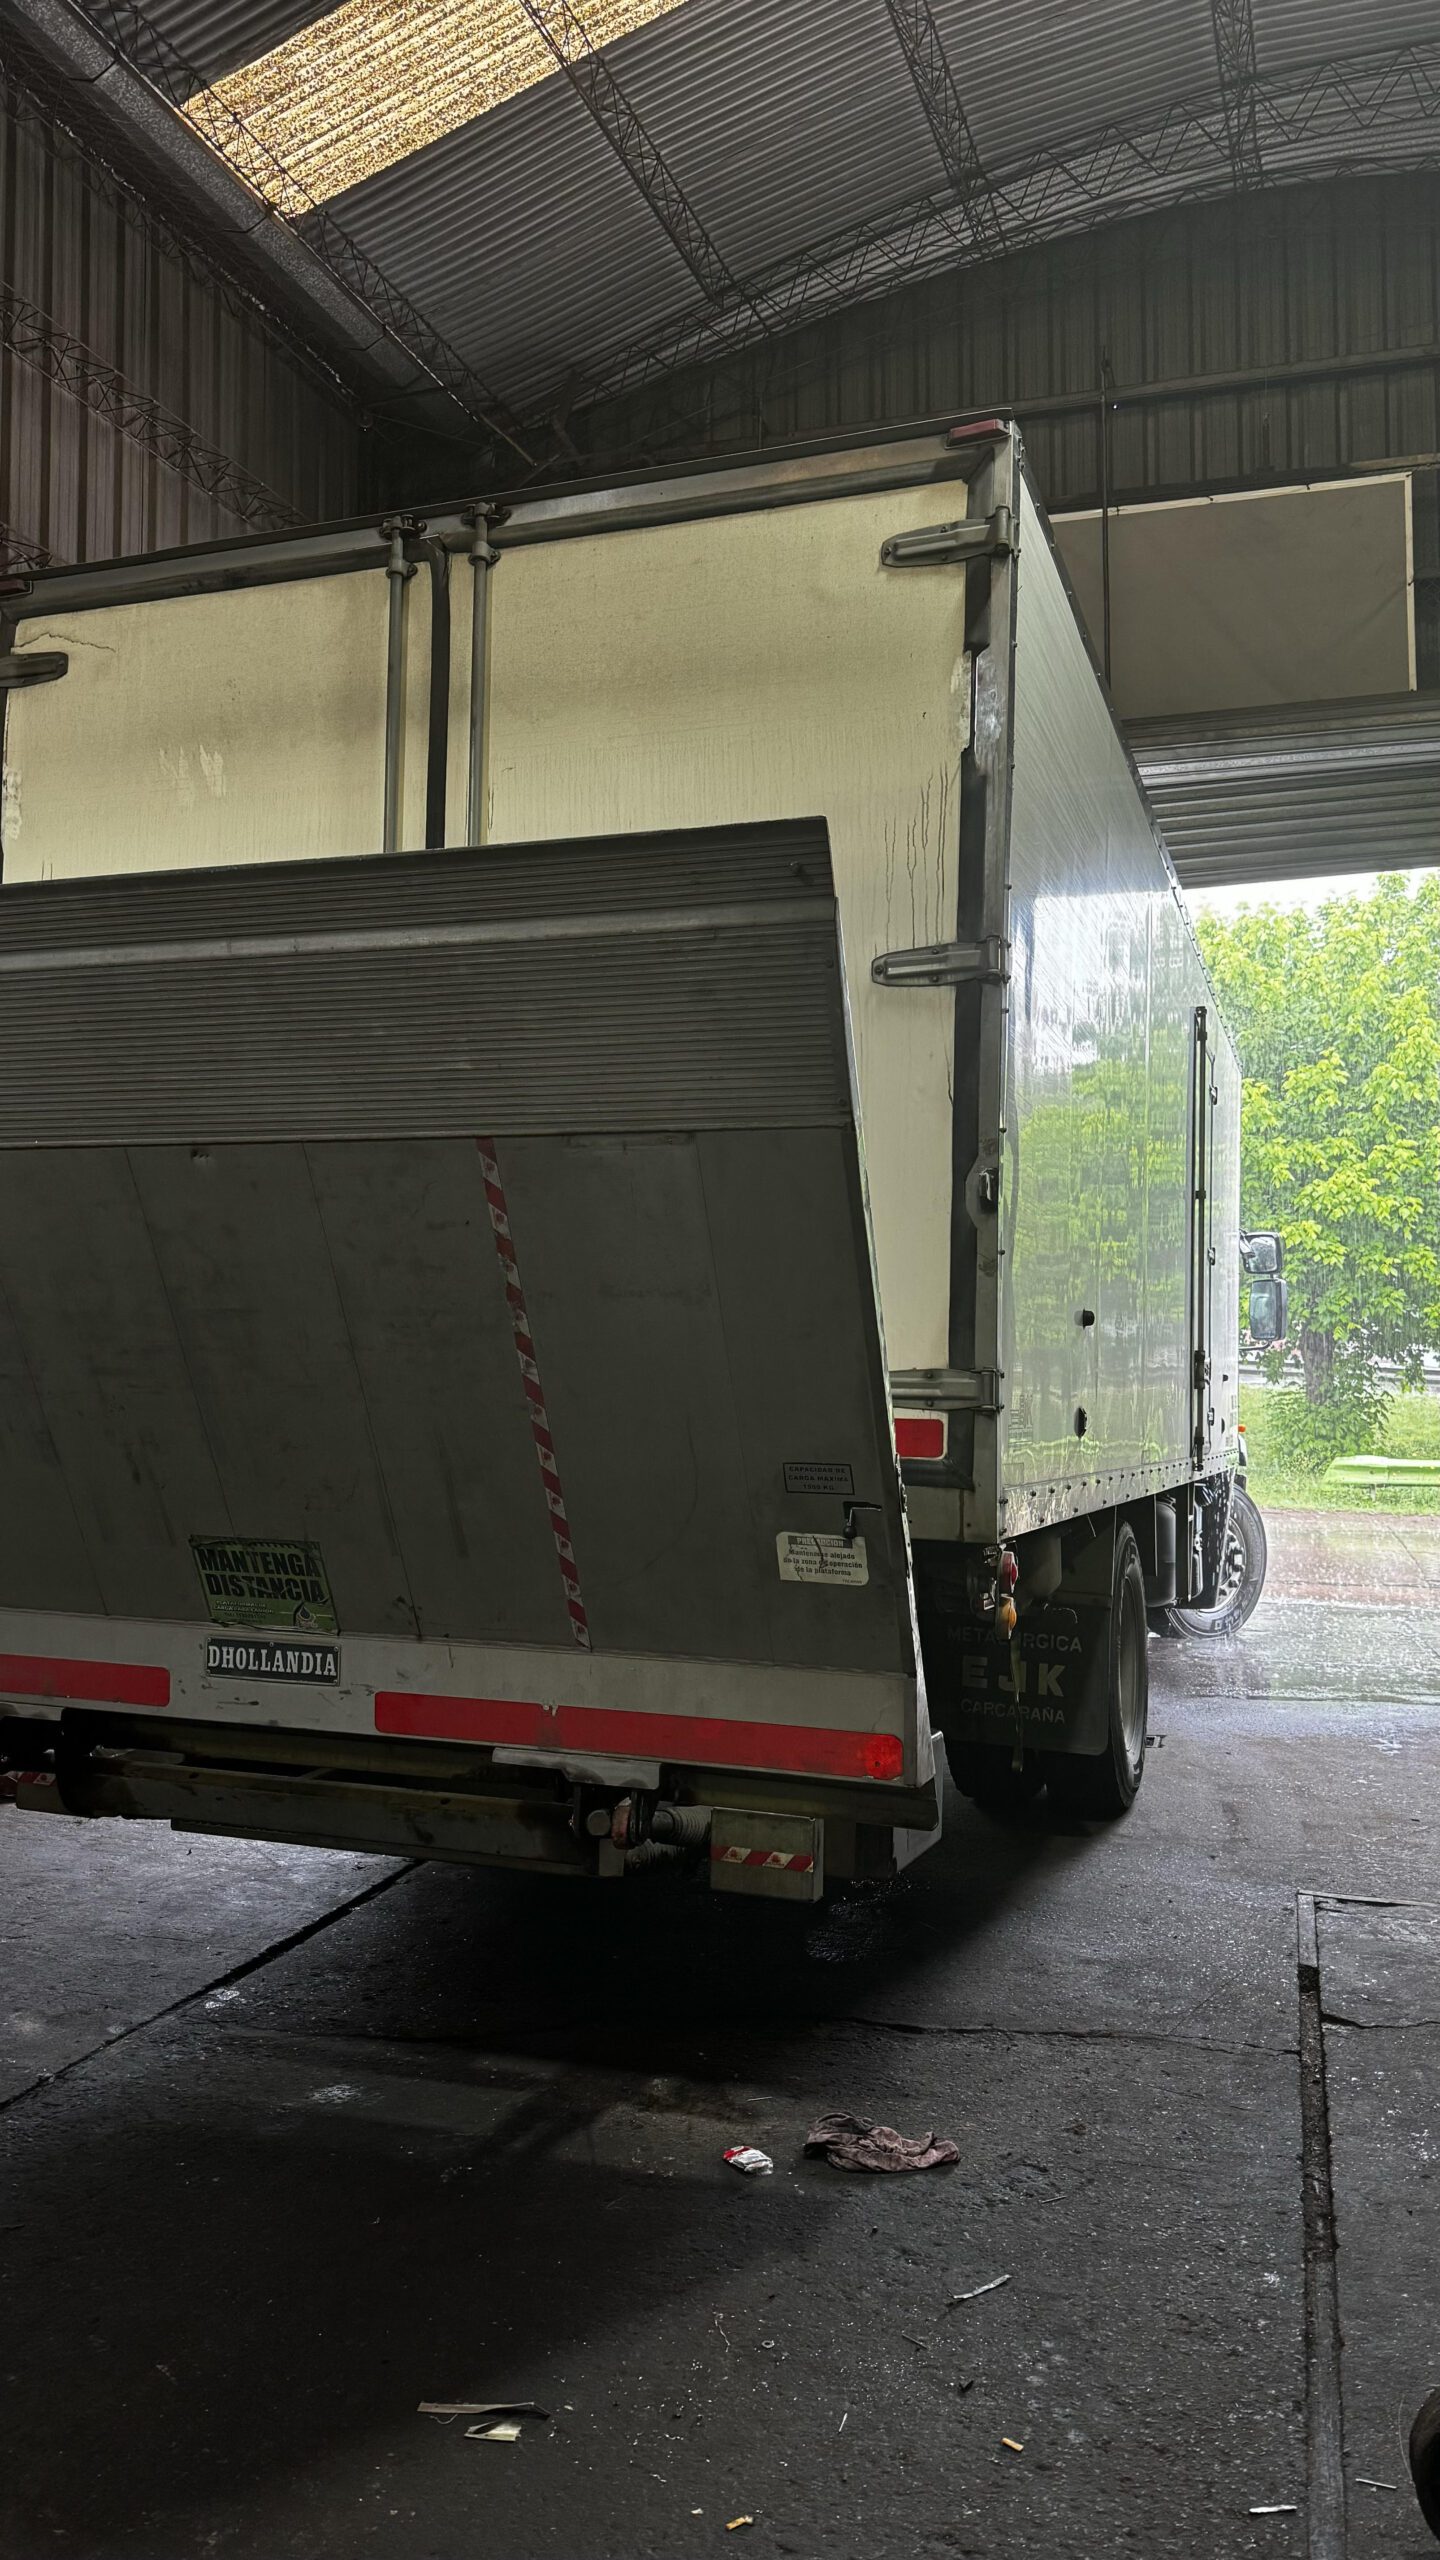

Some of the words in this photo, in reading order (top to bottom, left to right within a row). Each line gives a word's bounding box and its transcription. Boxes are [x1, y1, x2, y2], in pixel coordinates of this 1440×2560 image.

[788, 1465, 833, 1473] CAPACIDAD
[196, 1548, 322, 1578] MANTENGA
[829, 1551, 856, 1561] alejado
[814, 1567, 852, 1576] plataforma
[205, 1573, 326, 1603] DISTANCIA
[947, 1625, 1083, 1654] METARGICA
[207, 1645, 337, 1676] DHOLLANDIA
[961, 1655, 1066, 1697] EJK
[960, 1698, 1065, 1724] CARCARAÑA
